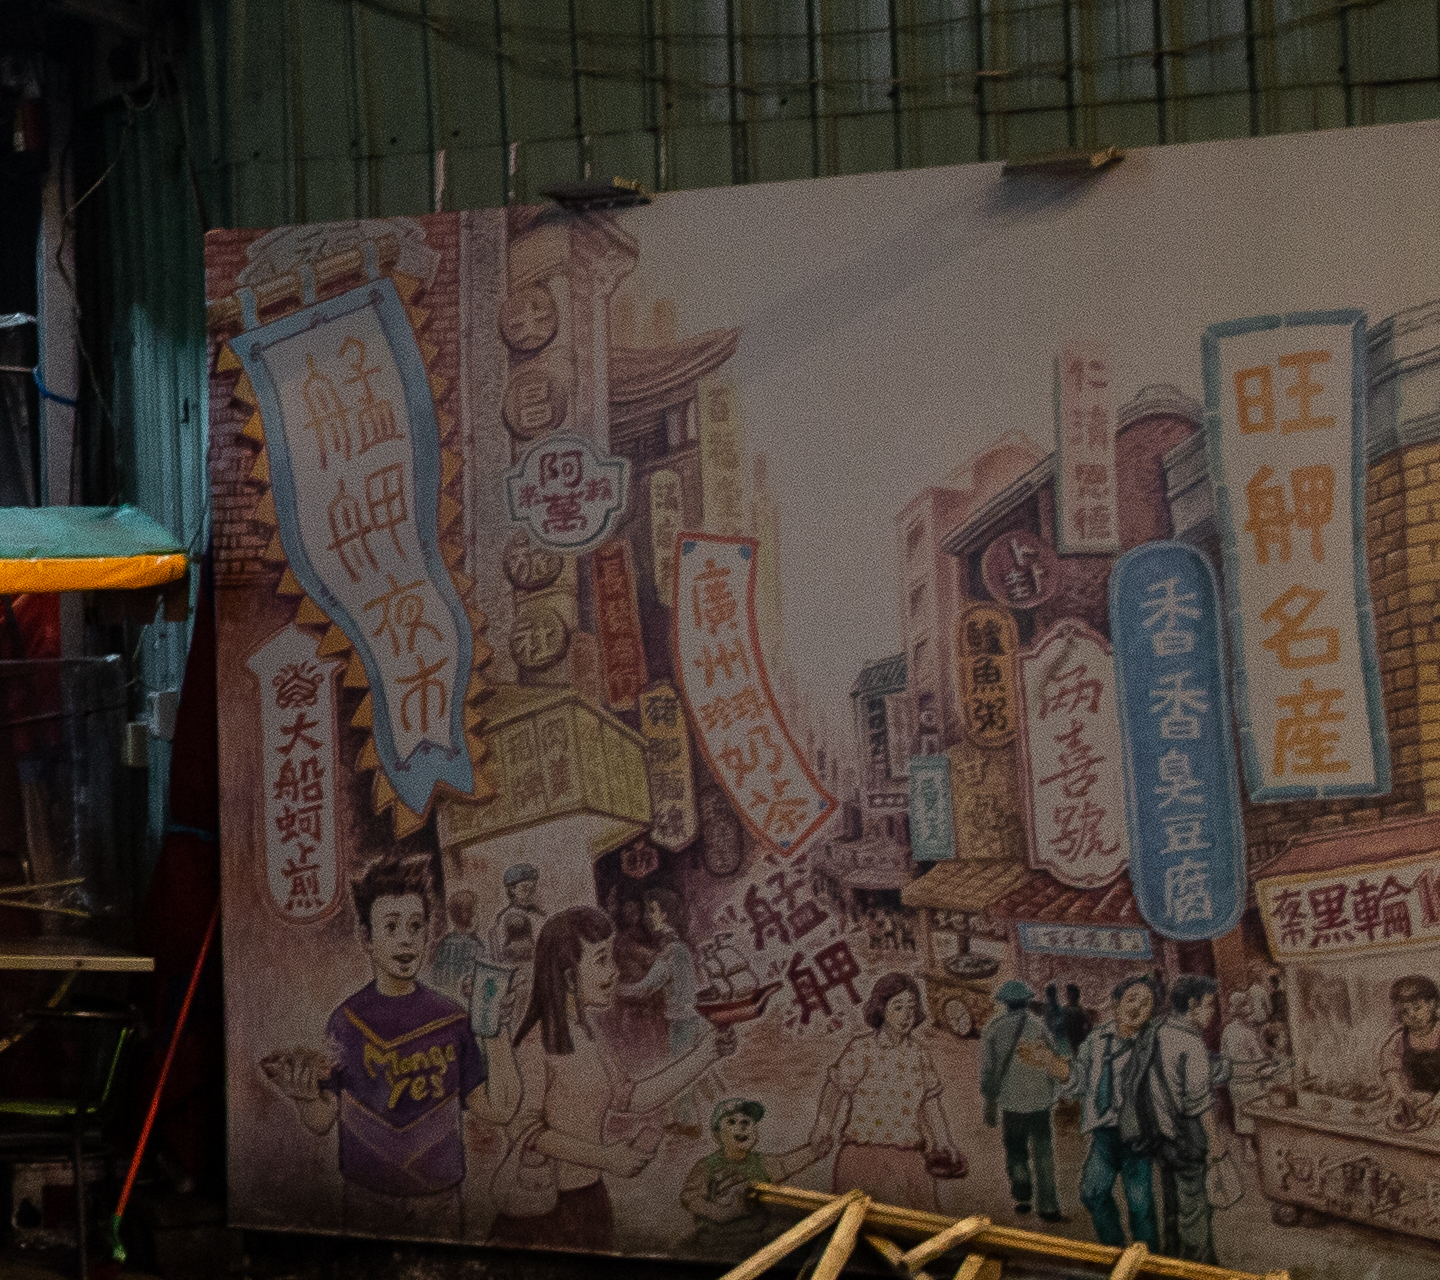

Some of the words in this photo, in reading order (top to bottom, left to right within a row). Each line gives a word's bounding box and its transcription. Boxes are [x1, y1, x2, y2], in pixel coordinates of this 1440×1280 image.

[298, 335, 448, 734] 艋舺夜市
[1233, 350, 1352, 777] 旺舺名產
[1038, 664, 1120, 862] 兩喜號
[1140, 576, 1215, 921] 香香臭豆腐
[744, 870, 864, 1026] 艋舺
